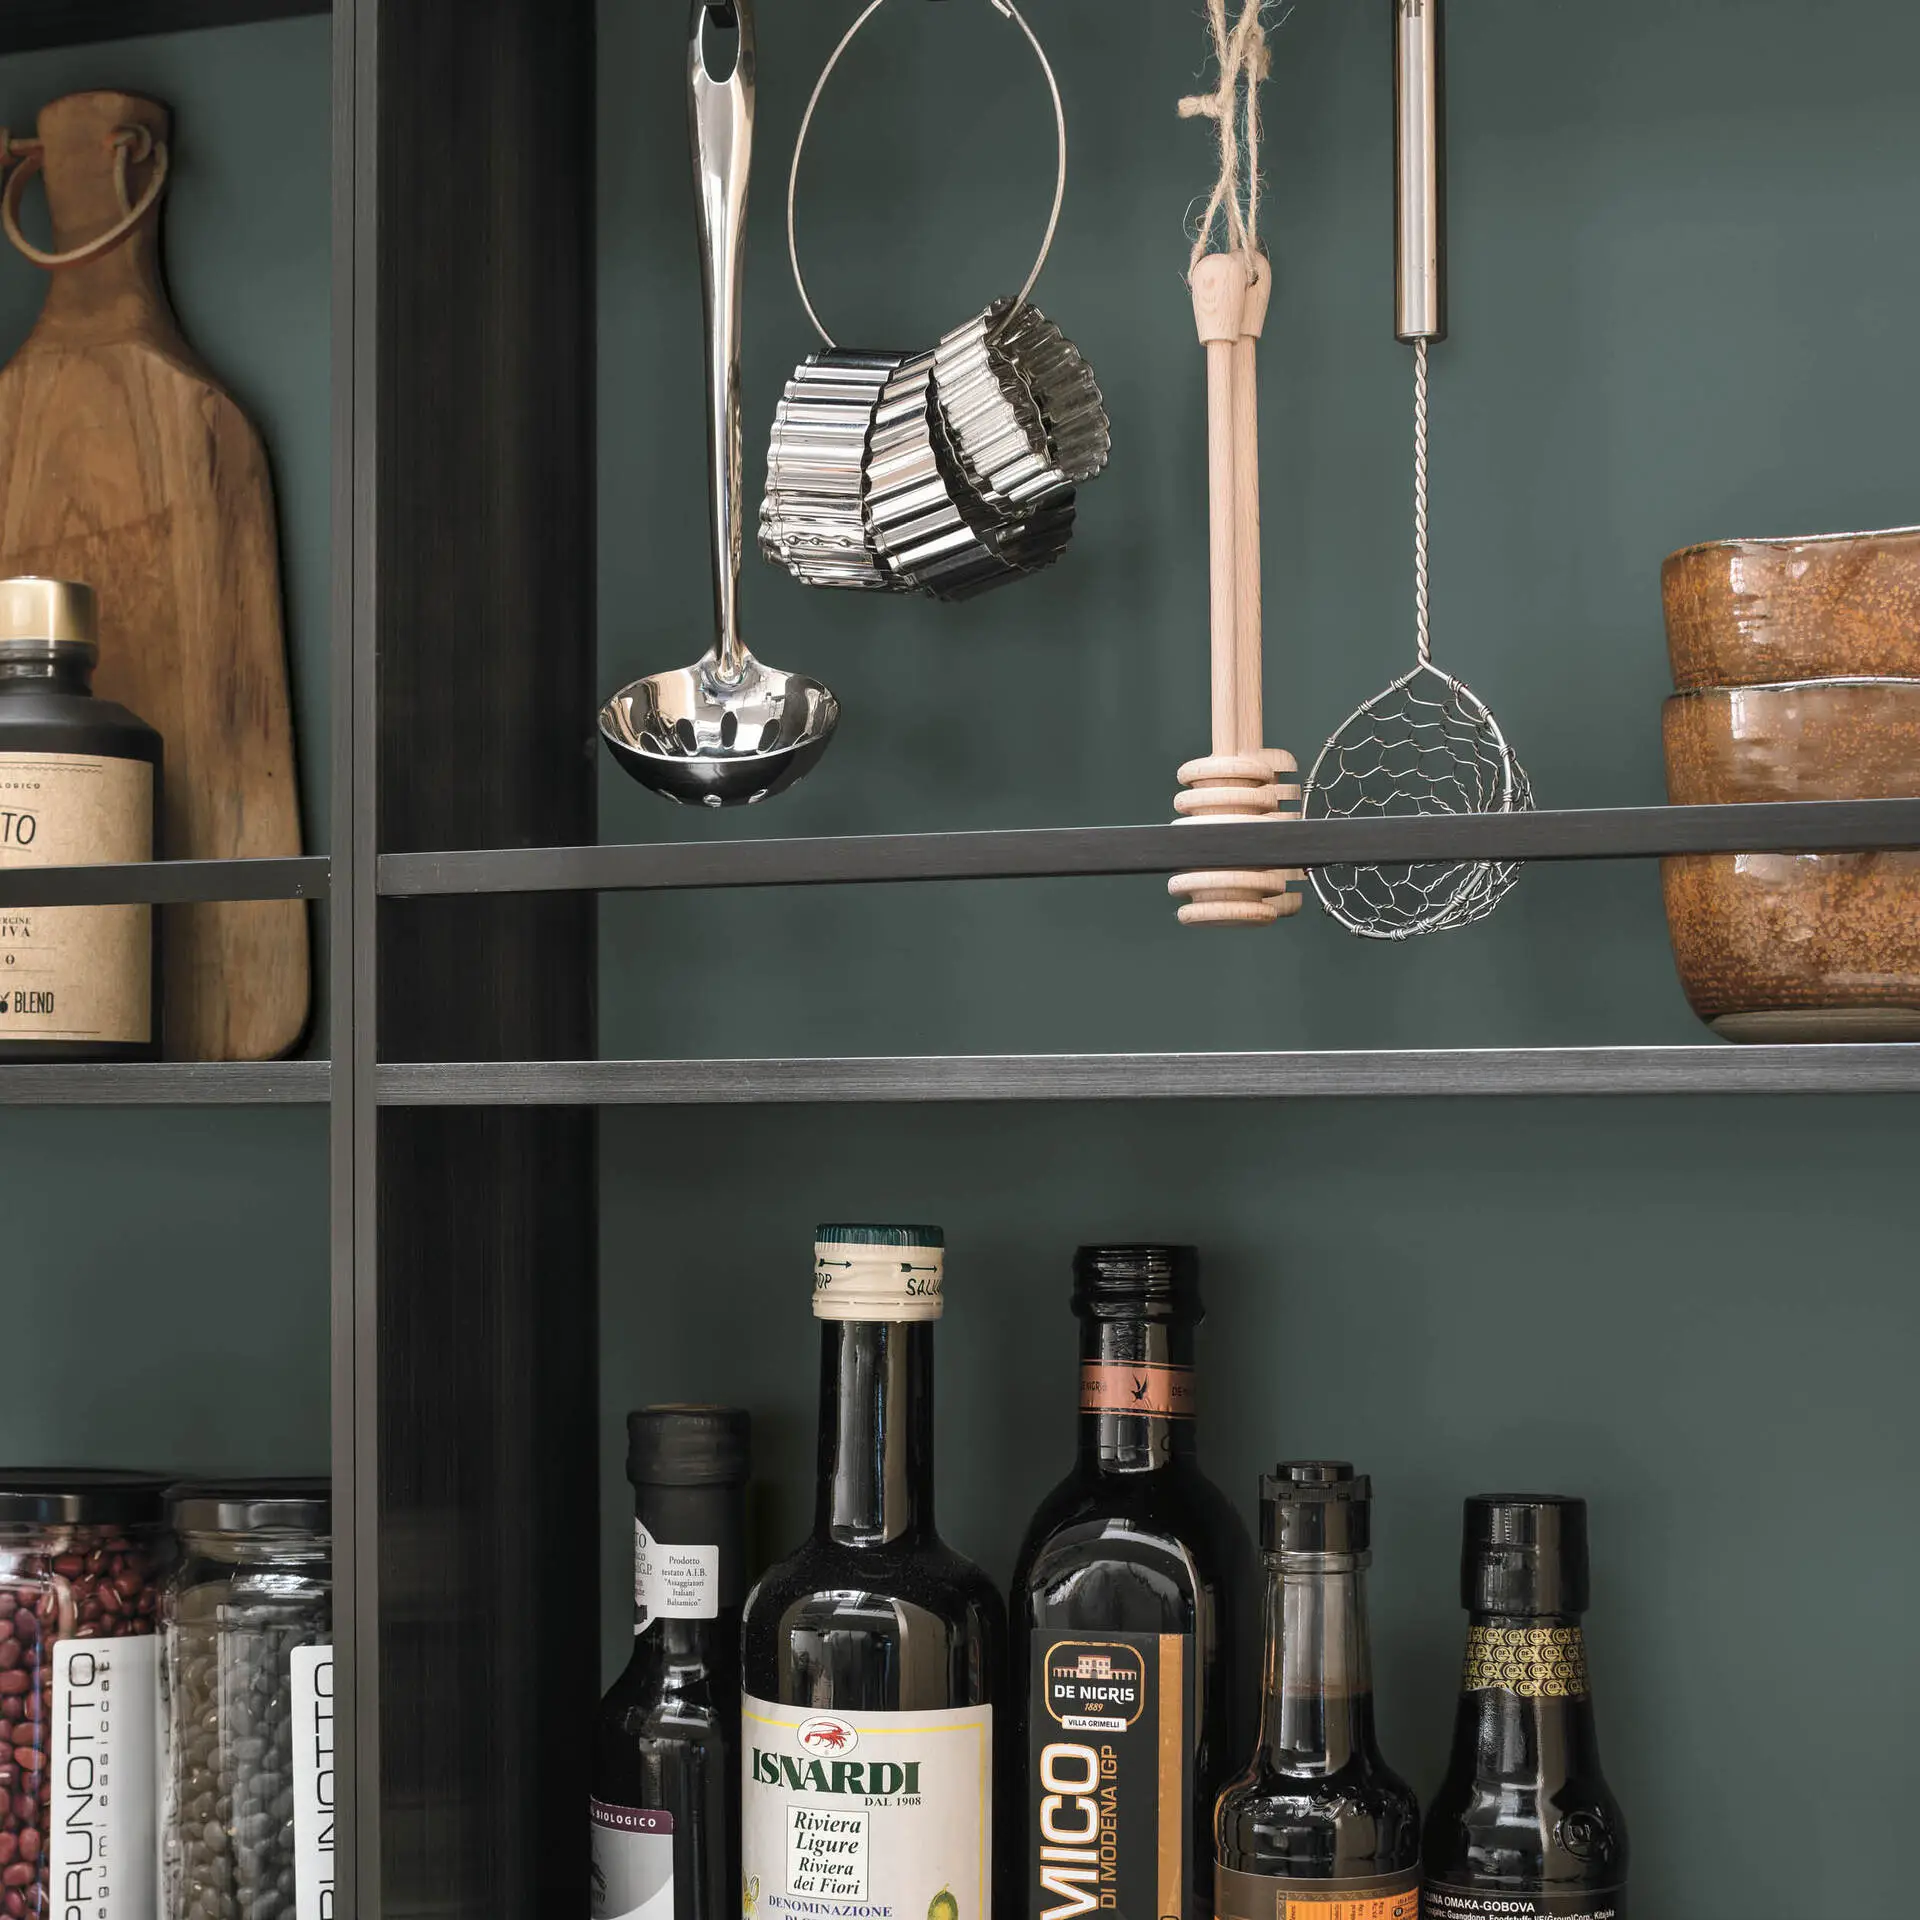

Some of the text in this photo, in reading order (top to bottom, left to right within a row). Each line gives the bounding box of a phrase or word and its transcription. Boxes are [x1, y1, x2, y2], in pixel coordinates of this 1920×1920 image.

[1, 812, 36, 844] TO
[15, 991, 54, 1014] BLEND
[669, 1555, 700, 1565] Prodotto
[1054, 1685, 1134, 1704] DE NIGRIS
[1084, 1703, 1104, 1712] 1889
[96, 1649, 111, 1807] essiccati
[1088, 1720, 1120, 1728] GRIMELLI
[752, 1747, 922, 1795] ISNARDI
[865, 1797, 922, 1806] DAL 1908
[597, 1809, 656, 1828] BIOLOGICO
[794, 1811, 861, 1833] Riviera
[1100, 1745, 1118, 1909] DI MODENA IGP
[796, 1832, 859, 1857] Ligure
[799, 1857, 854, 1876] Riviera
[793, 1876, 860, 1894] dei Fiori
[769, 1895, 893, 1917] DENOMINAZIONE
[1444, 1896, 1535, 1913] OMAKA-GOBOVA
